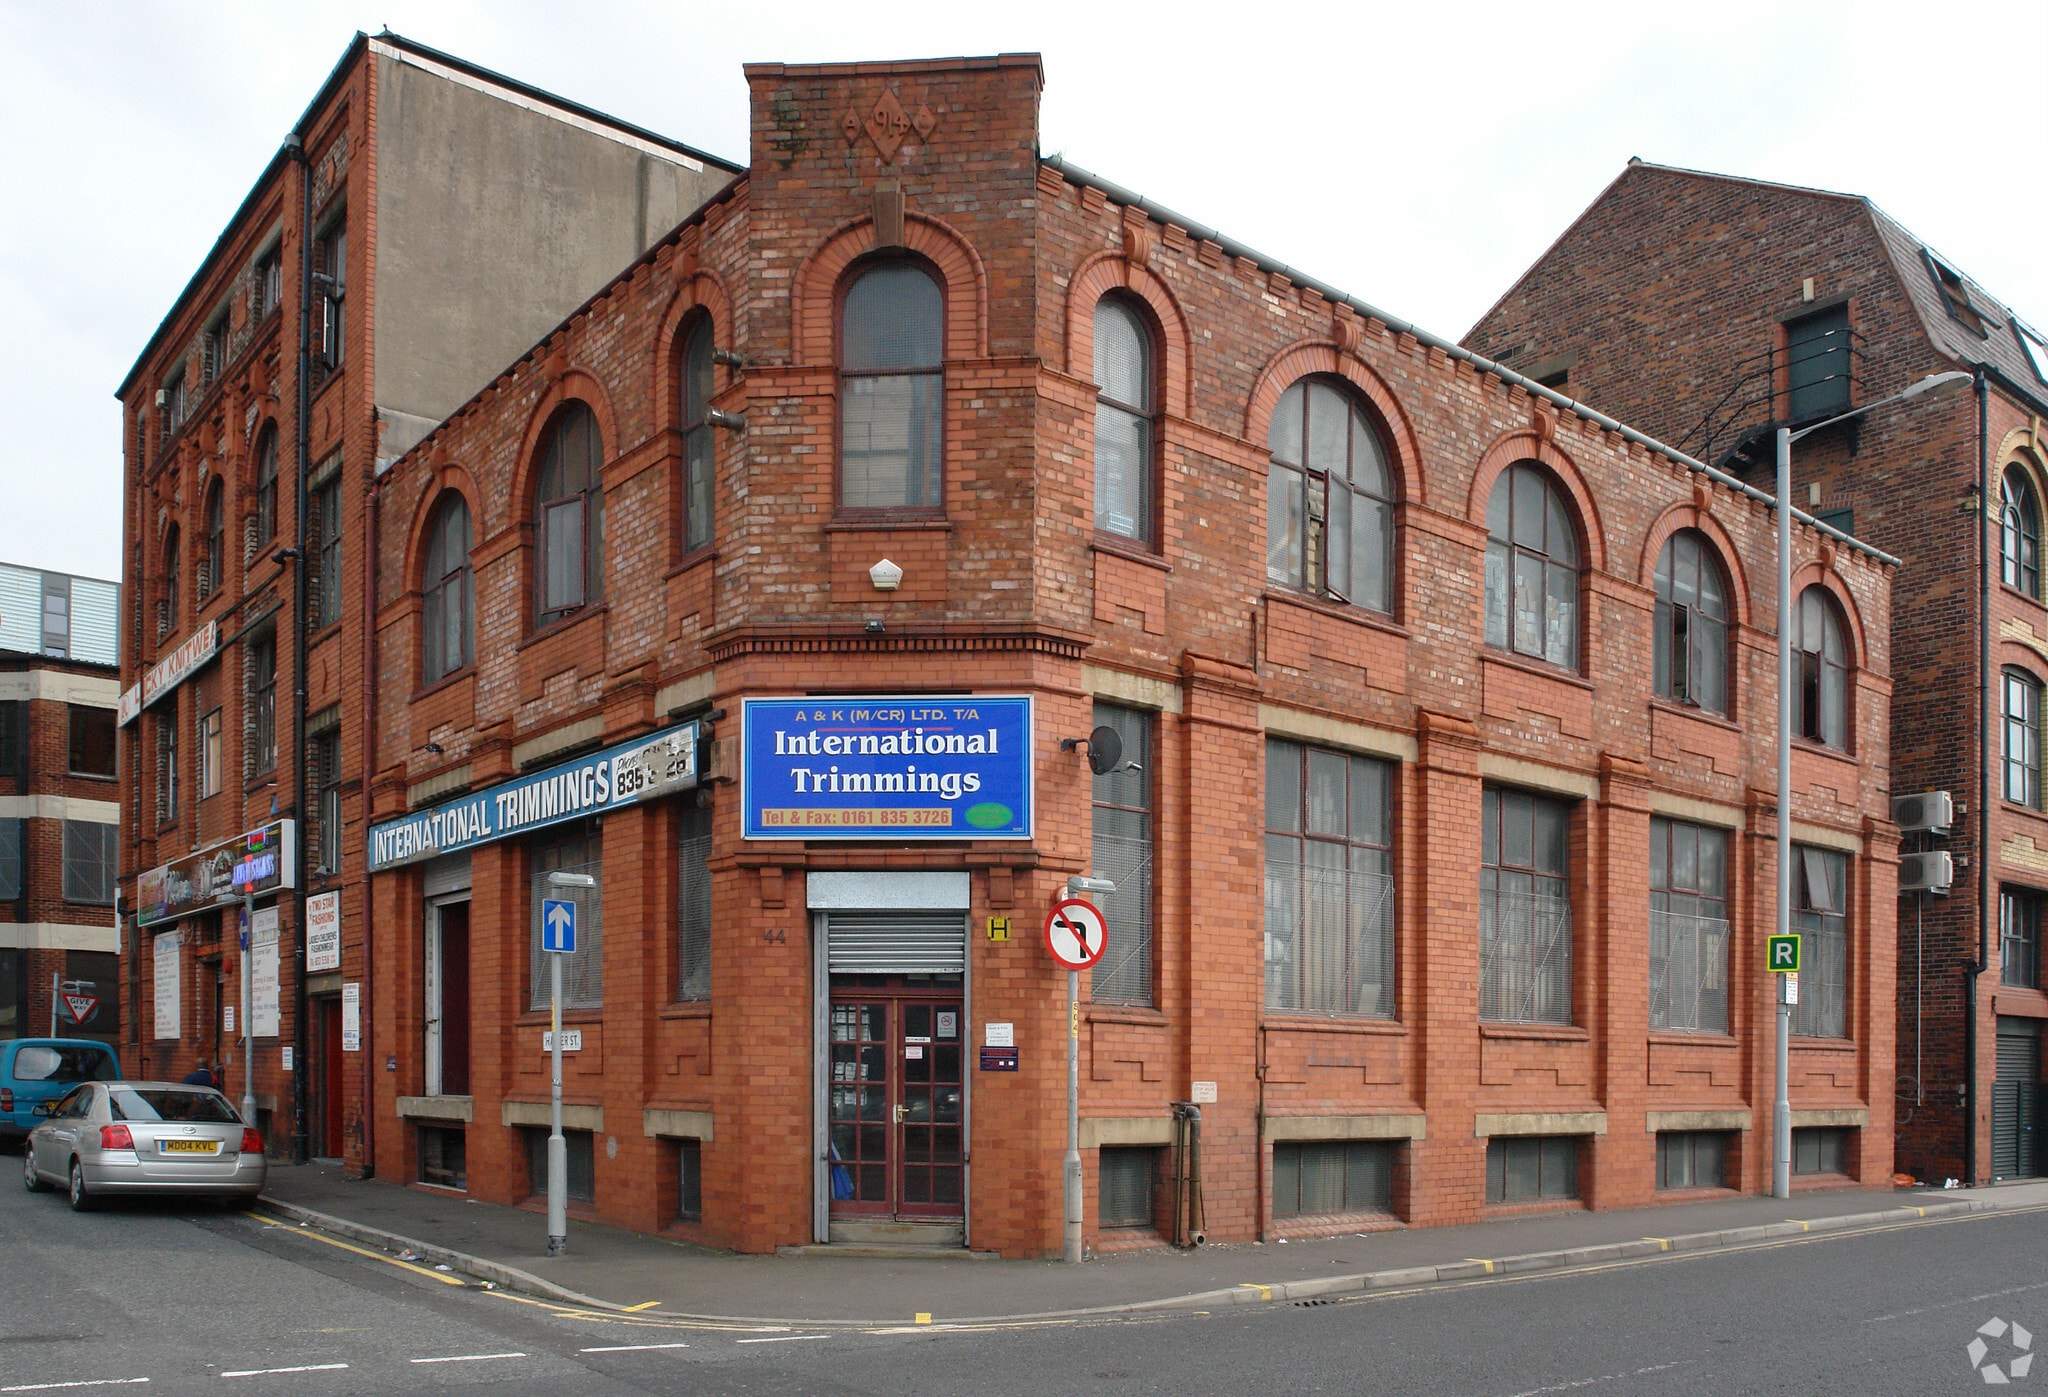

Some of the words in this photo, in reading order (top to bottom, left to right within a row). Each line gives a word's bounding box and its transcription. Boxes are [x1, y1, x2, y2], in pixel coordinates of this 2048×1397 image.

[795, 710, 807, 721] A
[814, 710, 826, 721] &
[832, 710, 844, 721] K
[850, 709, 906, 723] (M/CR)
[911, 709, 947, 720] LTD.
[953, 708, 980, 720] T/A
[774, 727, 999, 755] International
[617, 767, 644, 796] 835
[790, 765, 981, 801] Trimmings
[374, 799, 493, 866] INTERNATIONAL
[496, 760, 611, 832] TRIMMINGS
[764, 811, 784, 824] Tel
[790, 811, 800, 824] &
[806, 811, 837, 824] Fax:
[842, 811, 873, 824] 0161
[881, 810, 908, 824] 835
[913, 810, 949, 823] 3726
[763, 929, 786, 944] 44
[991, 918, 1008, 939] H
[1775, 943, 1793, 965] R
[195, 1141, 214, 1151] KVL
